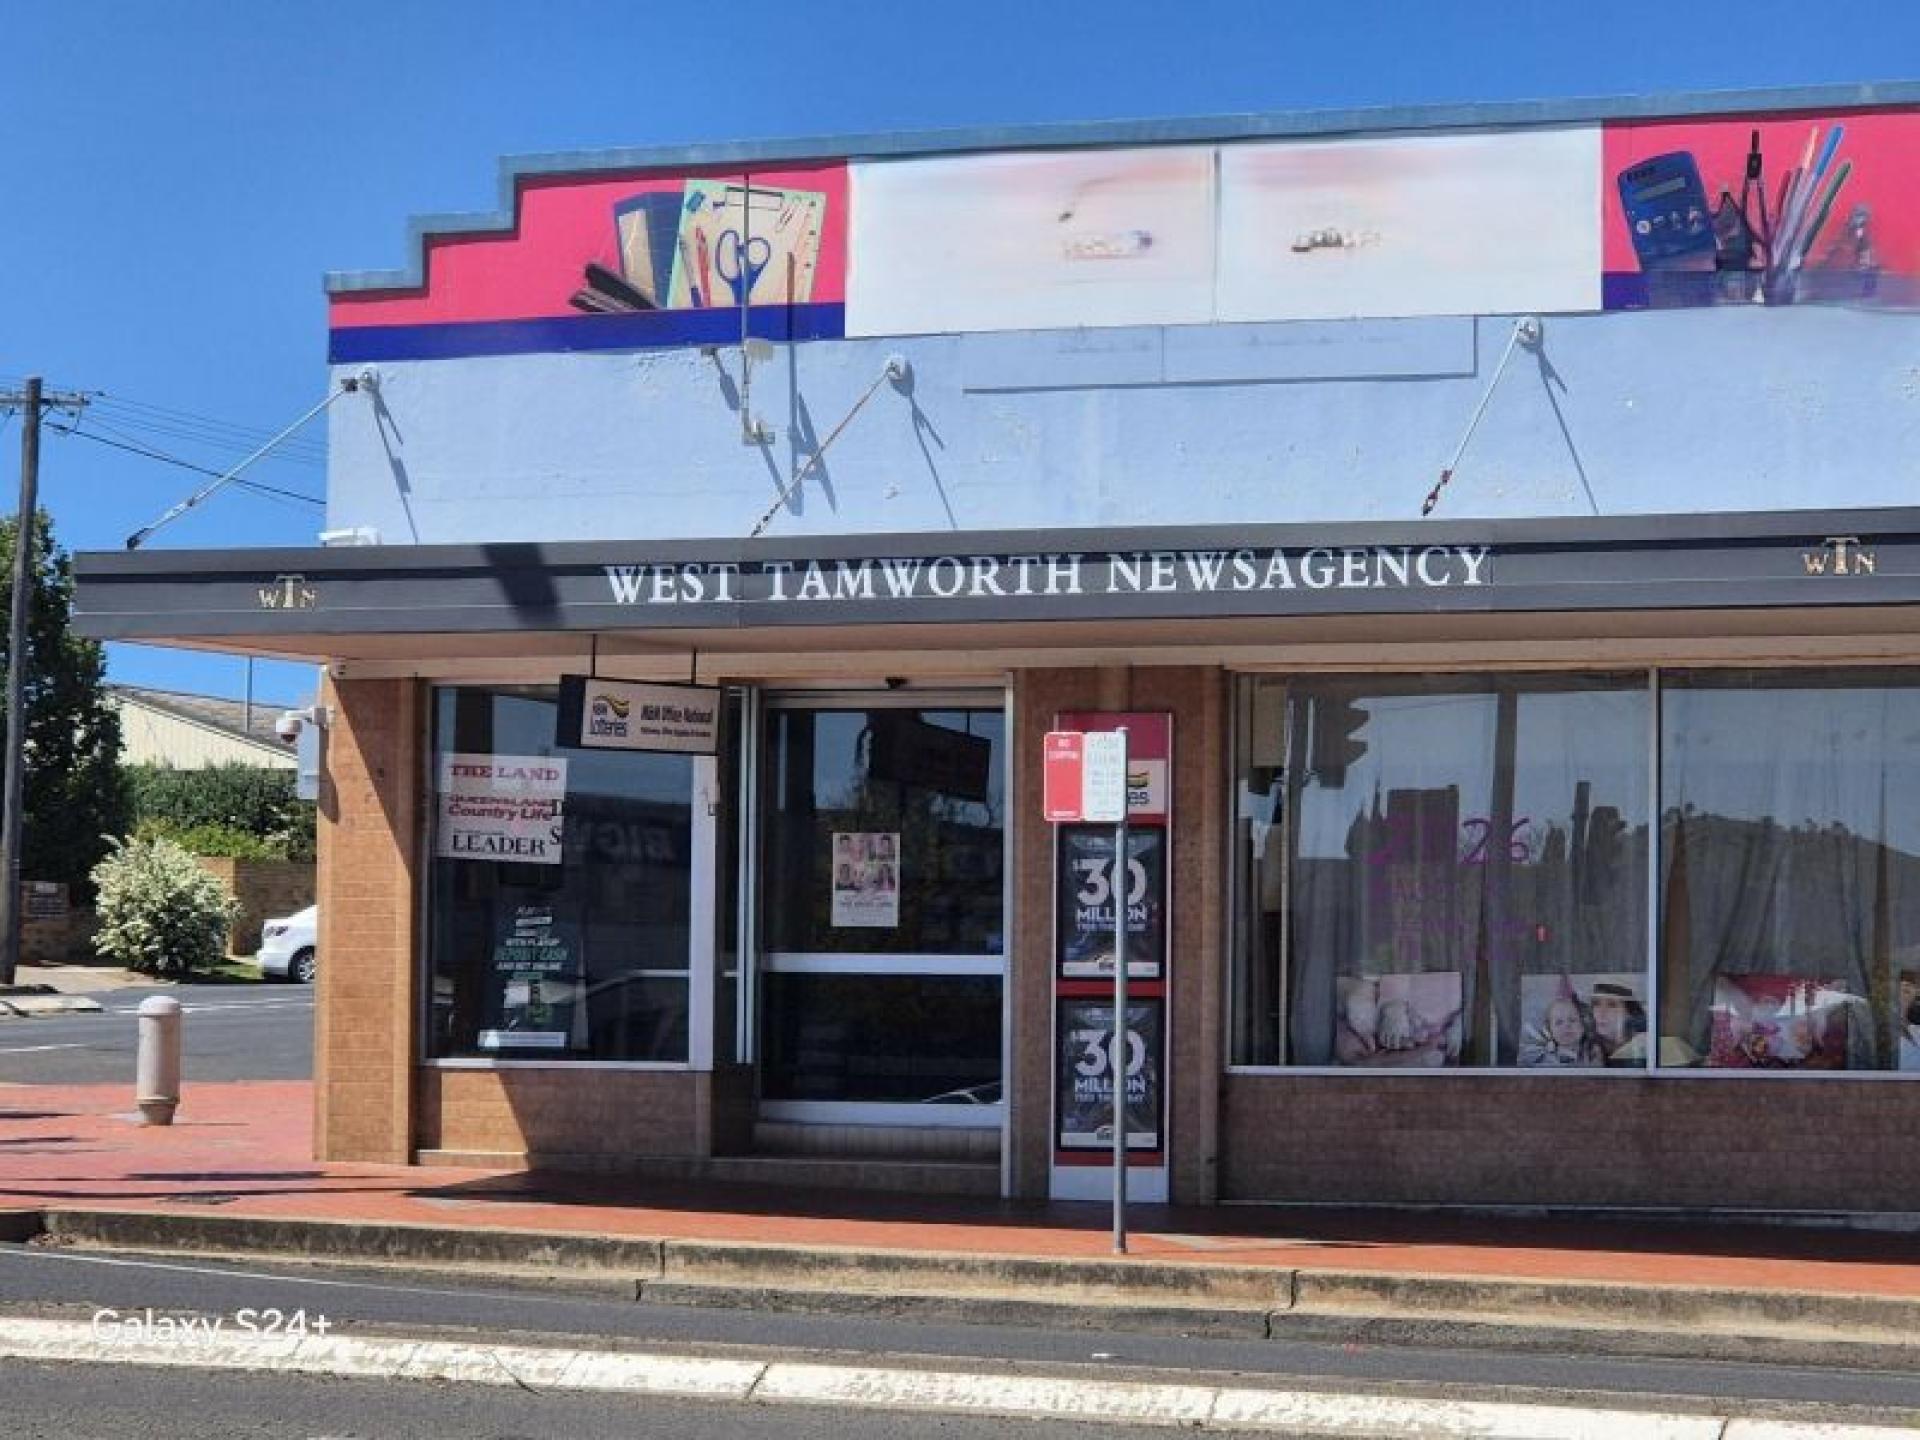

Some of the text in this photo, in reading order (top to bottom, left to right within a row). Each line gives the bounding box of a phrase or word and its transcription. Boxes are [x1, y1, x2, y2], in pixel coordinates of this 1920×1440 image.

[603, 545, 1492, 604] WEST TAMWORTH NEWSAGENCY
[449, 765, 560, 781] THE LAND
[449, 804, 517, 822] Country
[520, 806, 553, 822] Life
[452, 834, 546, 857] LEADER
